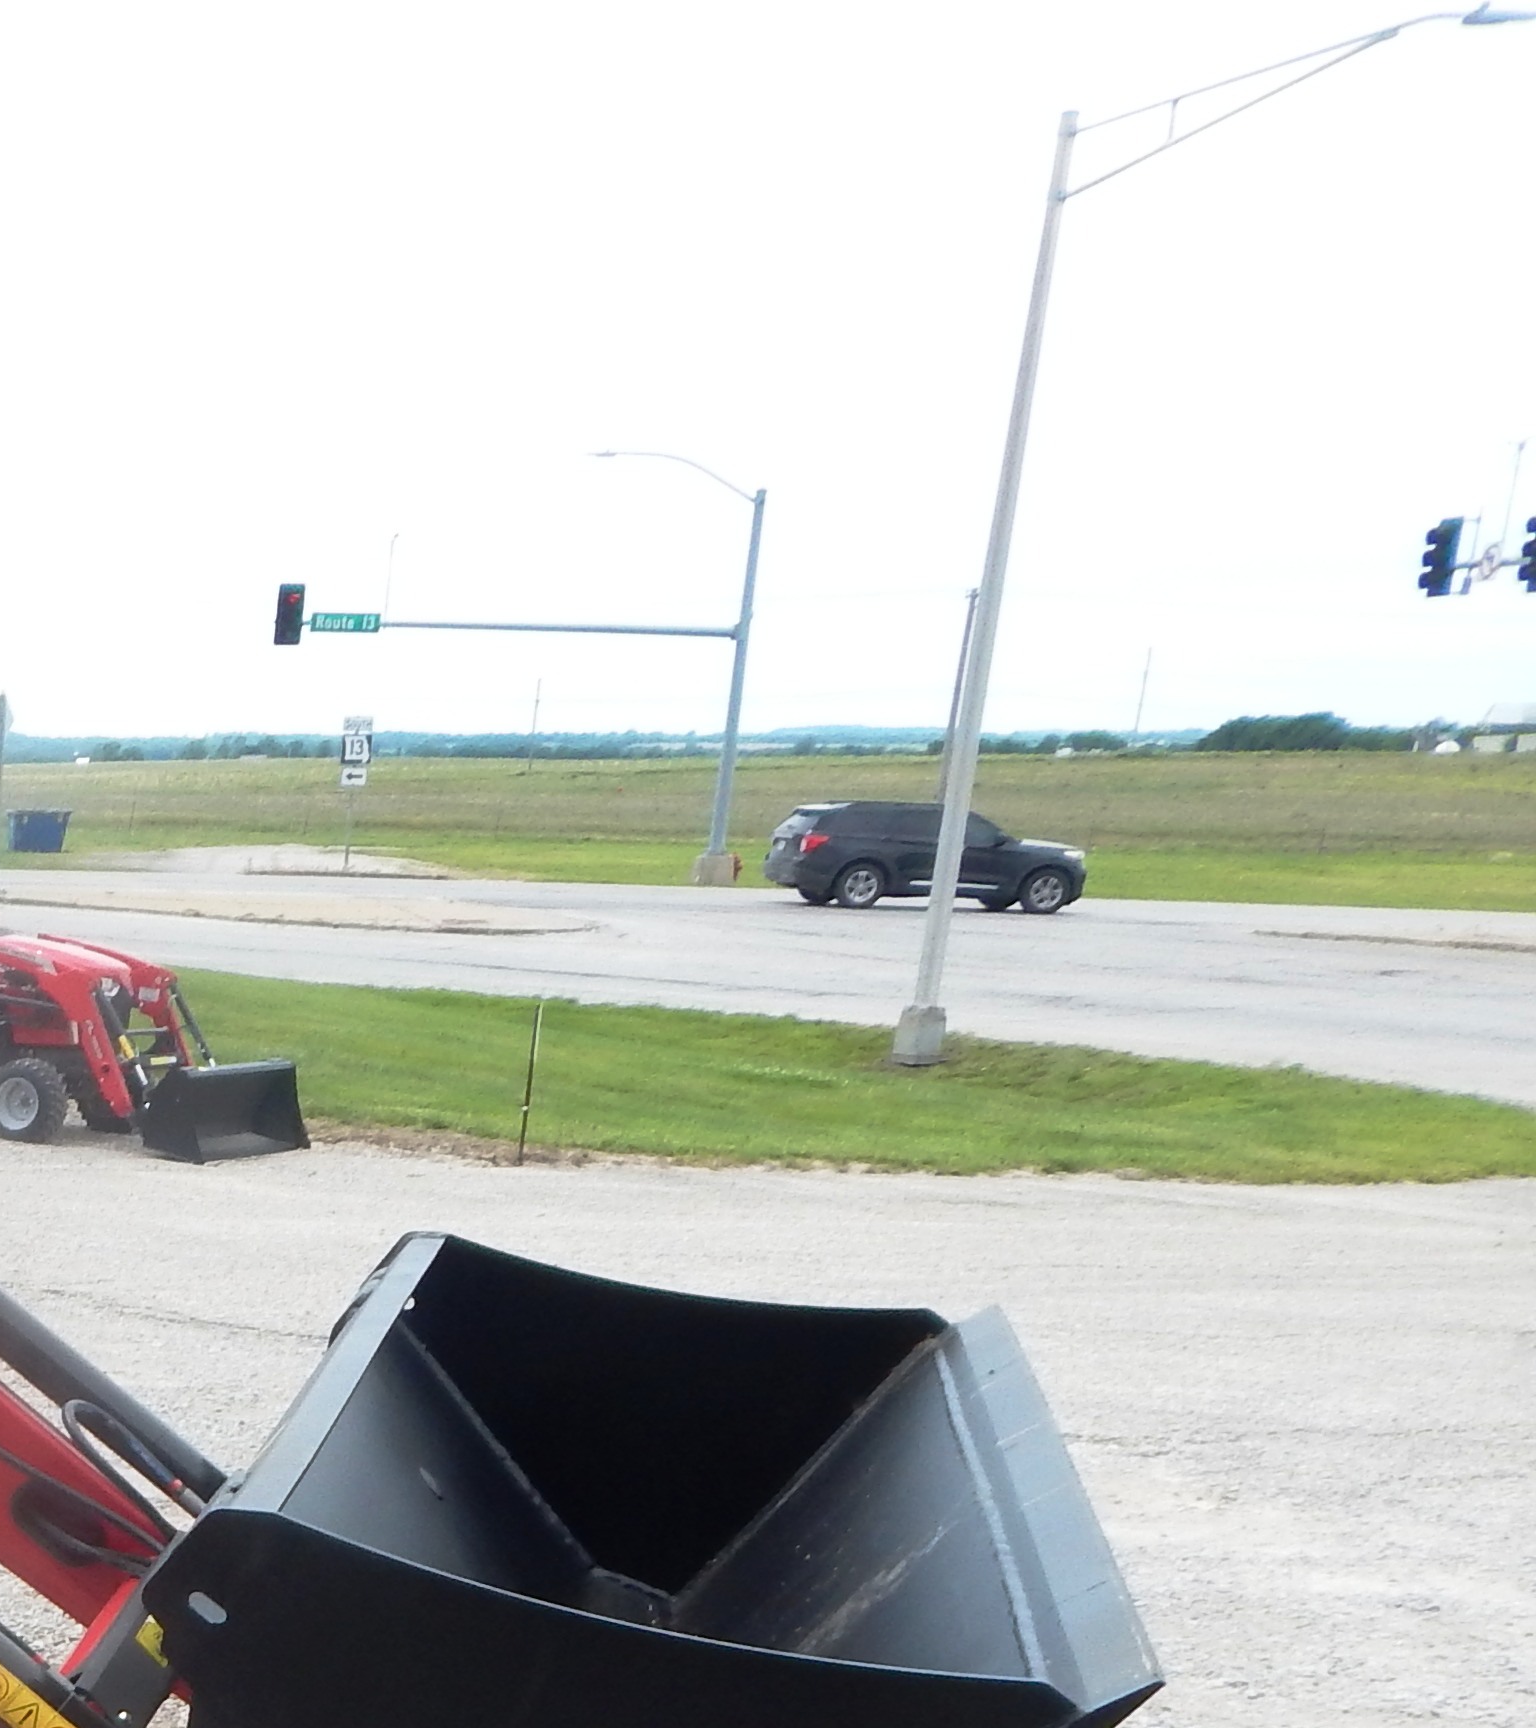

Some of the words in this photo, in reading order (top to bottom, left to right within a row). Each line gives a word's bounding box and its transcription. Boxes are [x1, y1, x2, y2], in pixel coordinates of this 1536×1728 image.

[315, 614, 355, 629] Route
[361, 614, 377, 630] 13
[350, 739, 364, 756] 13
